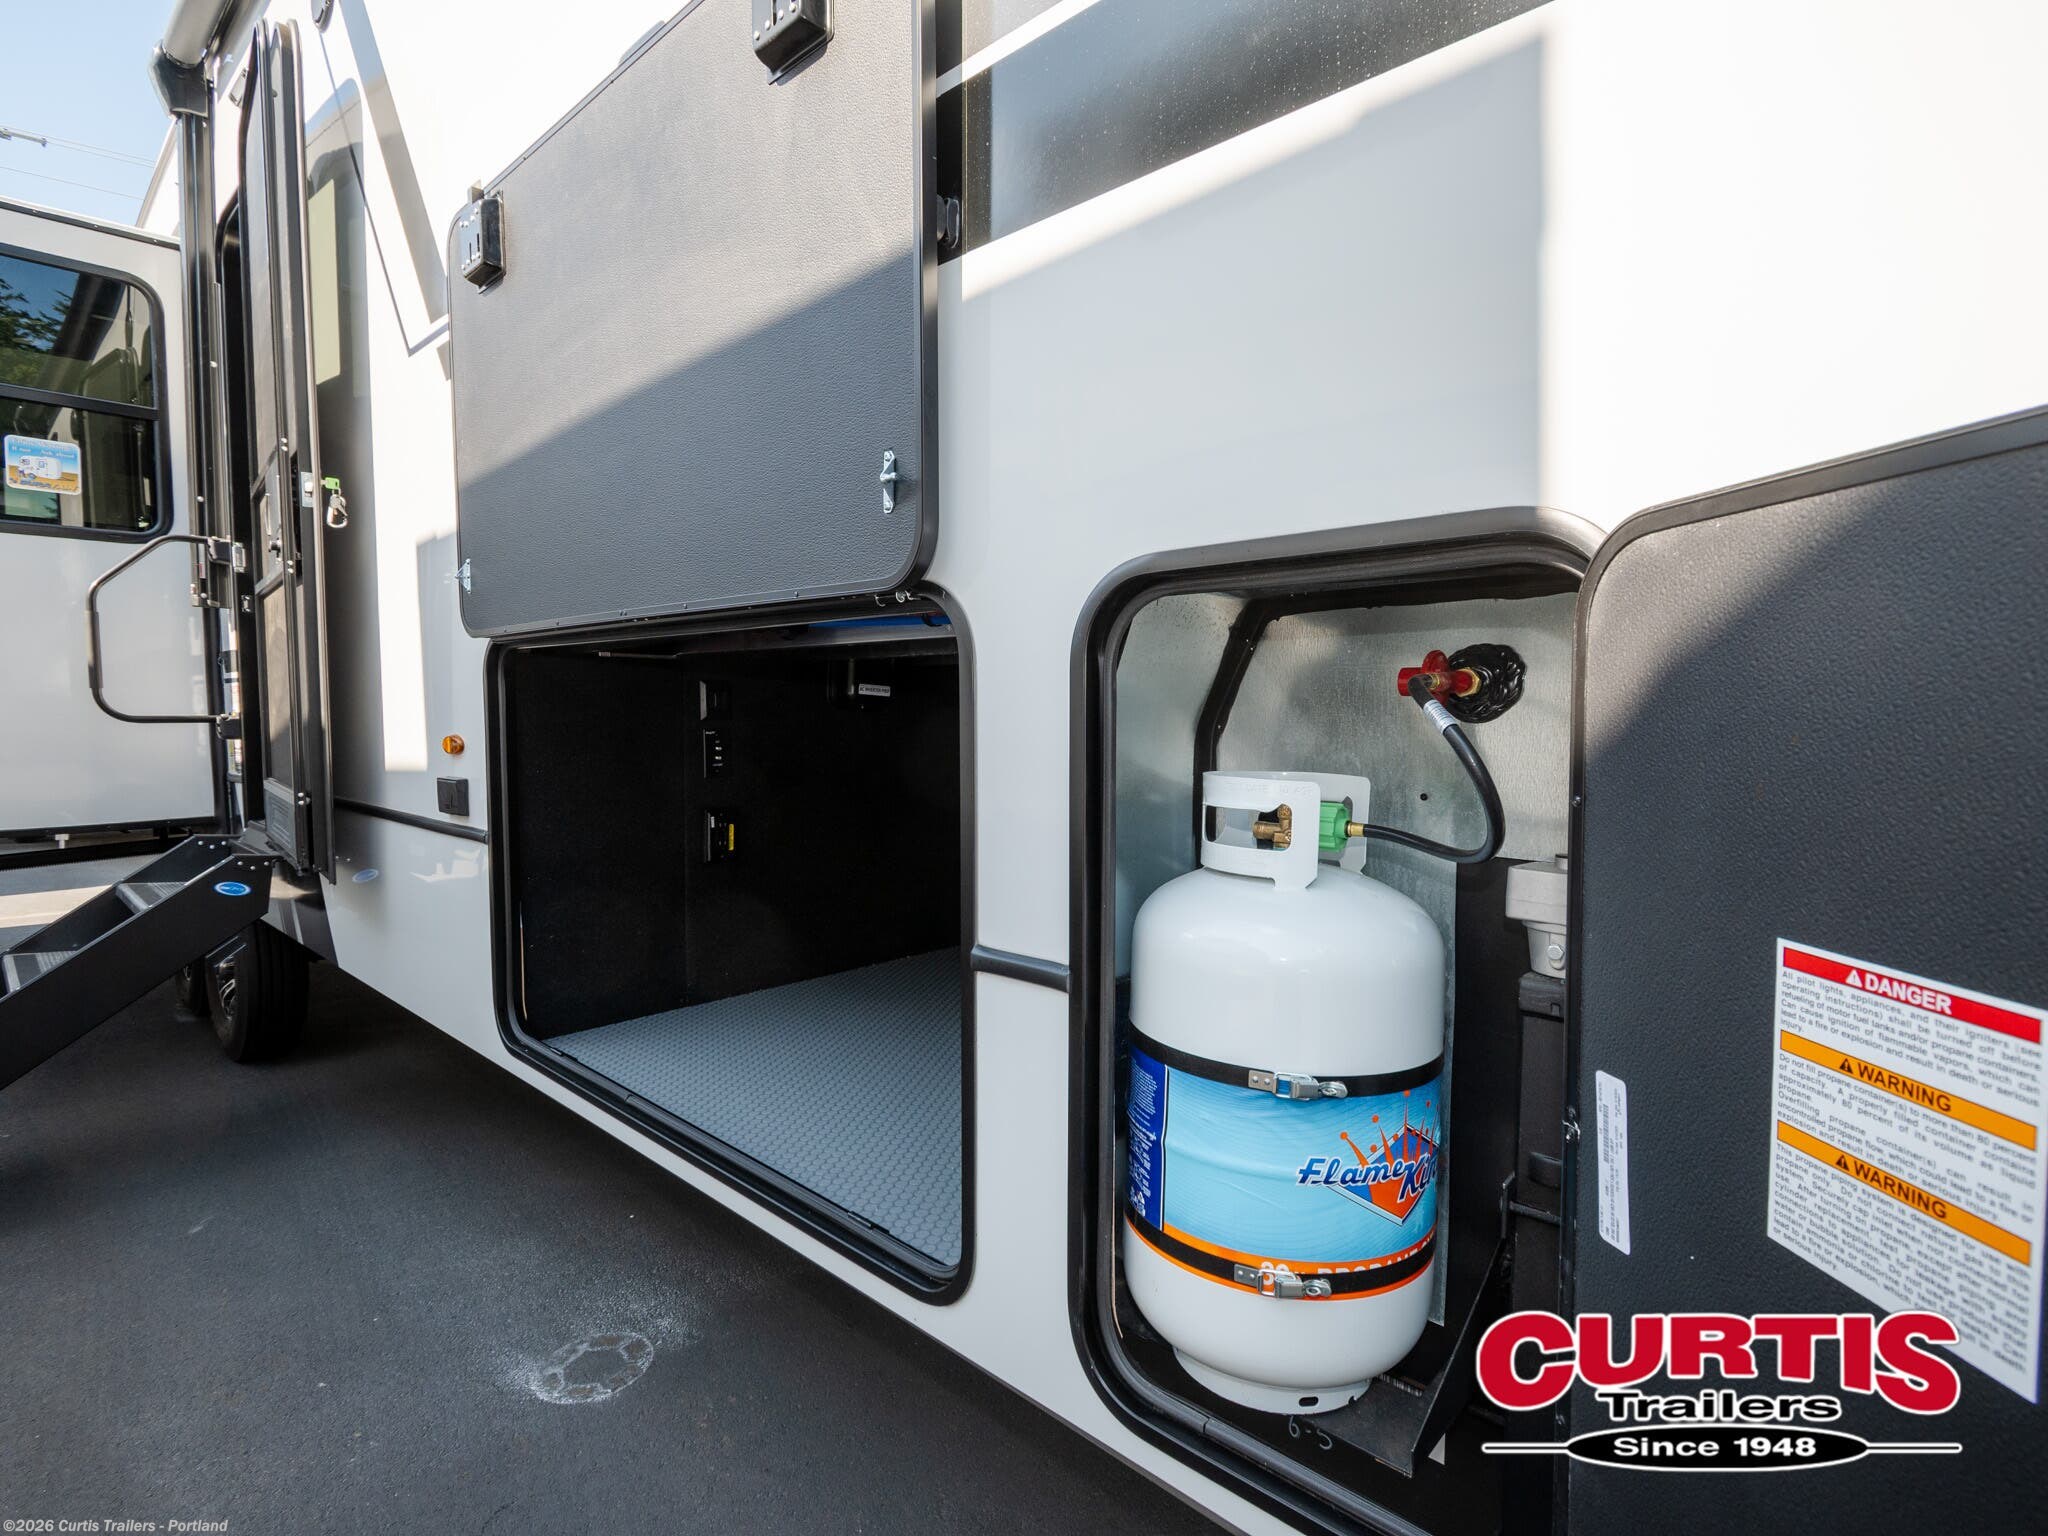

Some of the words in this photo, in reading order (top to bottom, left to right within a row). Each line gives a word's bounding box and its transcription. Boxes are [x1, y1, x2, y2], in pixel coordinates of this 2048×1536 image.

[1780, 998, 1796, 1009] Can
[1798, 1005, 1823, 1019] cause
[1827, 1014, 1860, 1032] ignition
[1864, 1028, 1873, 1036] of
[1877, 1030, 1927, 1055] flammable
[1781, 980, 1820, 1000] operating
[1824, 992, 1882, 1020] instructions)
[1888, 1015, 1911, 1028] shall
[1917, 1022, 1930, 1034] be
[1935, 1028, 1972, 1048] turned
[1781, 990, 1814, 1008] refueling
[1826, 1005, 1850, 1018] motor
[1852, 1012, 1869, 1025] fuel
[1871, 1018, 1895, 1034] tanks
[1898, 1029, 1928, 1045] and/or
[1930, 1040, 1973, 1060] propane
[1782, 970, 1793, 980] All
[1796, 976, 1815, 987] pilot
[1909, 1011, 1929, 1023] and
[1933, 1017, 1958, 1032] their
[1864, 974, 1952, 1015] DANGER
[1781, 1007, 1796, 1019] lead
[1798, 1013, 1806, 1022] to
[1815, 1019, 1827, 1030] fire
[1841, 1030, 1882, 1050] explosion
[1886, 1046, 1902, 1057] and
[1906, 1053, 1932, 1068] result
[1936, 1062, 1945, 1073] in
[1948, 1067, 1977, 1084] death
[1778, 1063, 1787, 1072] of
[1837, 1086, 1844, 1096] A
[1847, 1092, 1887, 1116] properly
[1893, 1109, 1918, 1127] filled
[1924, 1124, 1976, 1151] container
[1778, 1073, 1836, 1104] approximately
[1841, 1098, 1852, 1109] 80
[1857, 1106, 1892, 1127] percent
[1898, 1124, 1908, 1134] of
[1914, 1129, 1926, 1142] its
[1933, 1139, 1973, 1162] volume
[1779, 1052, 1789, 1063] Do
[1792, 1059, 1804, 1069] not
[1806, 1063, 1814, 1073] fill
[1818, 1070, 1850, 1088] propane
[1854, 1085, 1906, 1113] container(s)
[1910, 1105, 1918, 1116] to
[1922, 1112, 1946, 1128] more
[1858, 1062, 1952, 1112] WARNING
[1777, 1100, 1826, 1128] uncontrolled
[1827, 1123, 1862, 1144] propane
[1888, 1151, 1916, 1169] which
[1918, 1165, 1947, 1184] could
[1949, 1177, 1972, 1195] lead
[1777, 1109, 1816, 1132] explosion
[1819, 1129, 1834, 1141] and
[1837, 1138, 1862, 1155] result
[1865, 1149, 1874, 1160] in
[1877, 1155, 1904, 1174] death
[1907, 1171, 1917, 1181] or
[1921, 1178, 1961, 1202] serious
[1778, 1090, 1819, 1116] Overfilling
[1829, 1114, 1865, 1135] propane
[1876, 1135, 1936, 1170] container(s)
[1946, 1167, 1965, 1181] can
[1297, 1156, 1406, 1186] Flame
[1397, 1152, 1437, 1202] Kin
[1776, 1153, 1808, 1175] propane
[1840, 1185, 1852, 1198] Do
[1856, 1195, 1871, 1208] not
[1876, 1206, 1915, 1231] connect
[1920, 1229, 1958, 1254] natural
[1777, 1142, 1792, 1156] This
[1795, 1153, 1828, 1175] propane
[1830, 1172, 1857, 1192] piping
[1861, 1187, 1894, 1209] system
[1897, 1204, 1906, 1215] is
[1910, 1210, 1956, 1242] designed
[1854, 1160, 1948, 1219] WARNING
[1774, 1180, 1807, 1202] cylinder
[1879, 1236, 1898, 1254] test
[1905, 1252, 1950, 1283] propane
[1797, 1182, 1816, 1198] After
[1820, 1194, 1851, 1219] turning
[1855, 1215, 1866, 1225] on
[1917, 1248, 1951, 1272] except
[1812, 1180, 1848, 1208] Securely
[1852, 1203, 1868, 1218] cap
[1872, 1212, 1892, 1230] inlet
[1896, 1227, 1922, 1246] when
[1927, 1243, 1943, 1257] not
[1948, 1254, 2006, 1291] connected
